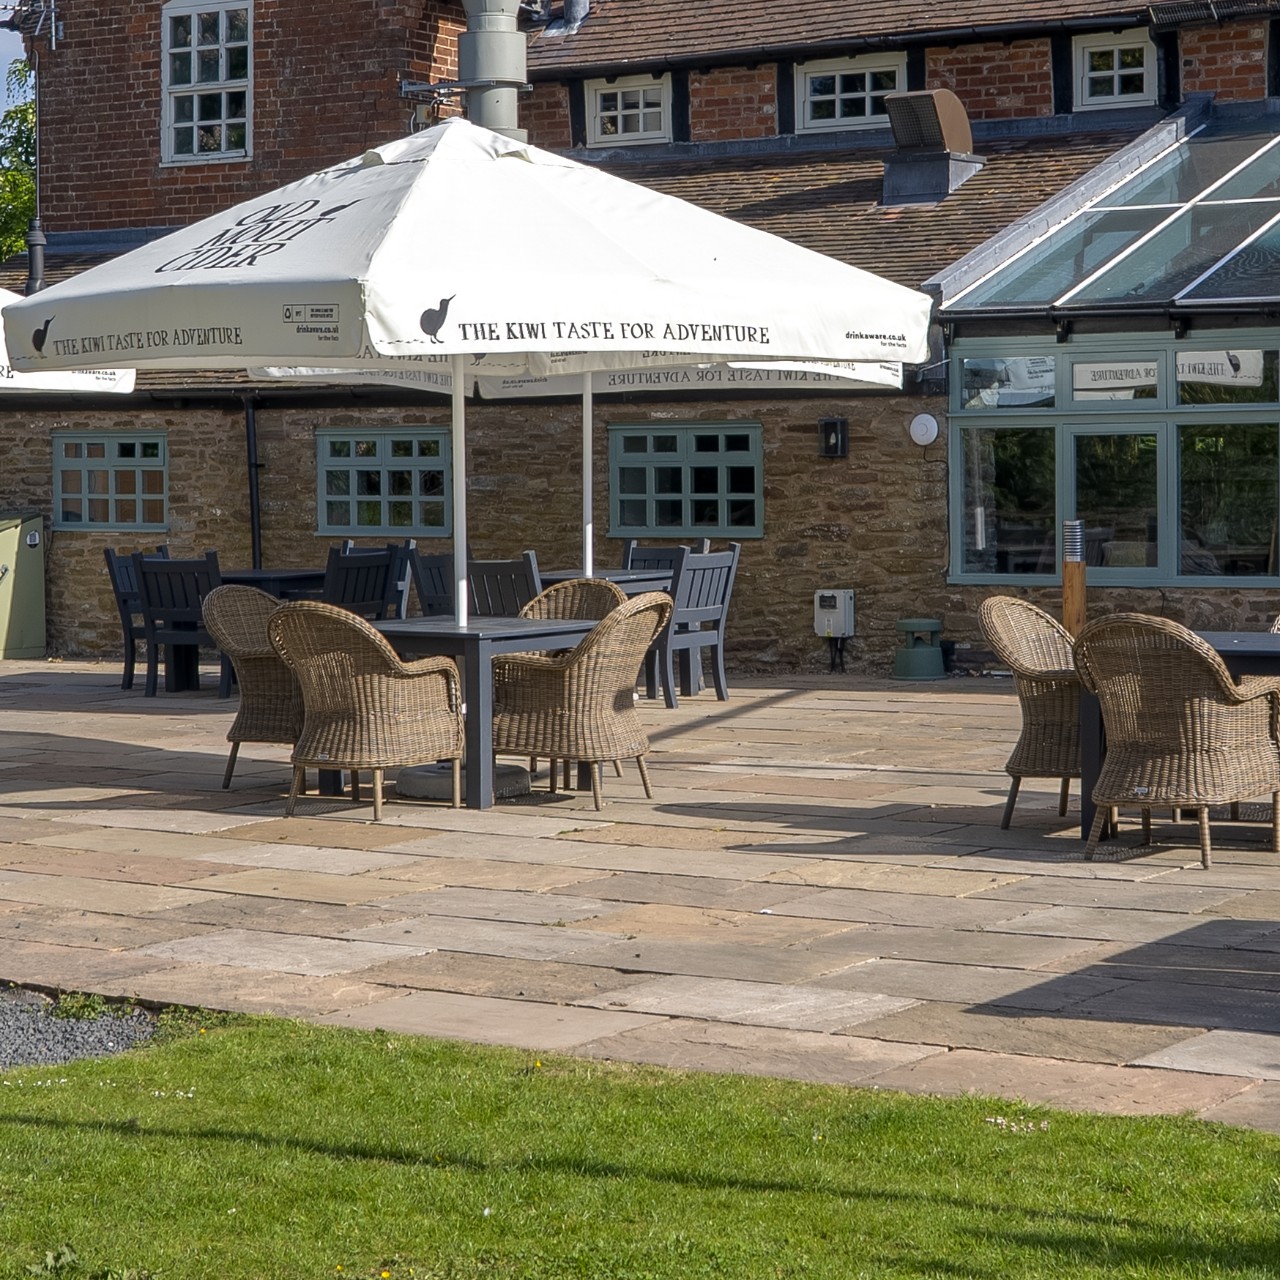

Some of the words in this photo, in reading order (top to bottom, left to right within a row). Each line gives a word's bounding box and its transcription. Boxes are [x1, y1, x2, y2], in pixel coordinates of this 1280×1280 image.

[235, 199, 320, 226] OLD
[191, 217, 336, 250] MOUT
[154, 243, 286, 273] CIDER
[53, 339, 79, 356] THE
[81, 335, 106, 353] KIWI
[107, 332, 144, 351] TASTE
[146, 330, 170, 348] FOR
[173, 327, 243, 346] ADVENTURE
[459, 322, 500, 341] THE
[506, 322, 547, 340] KIWI
[552, 322, 615, 340] TASTE
[620, 322, 655, 339] FOR
[663, 323, 770, 344] ADVENTURE
[845, 331, 907, 341] drinkaware.co.uk
